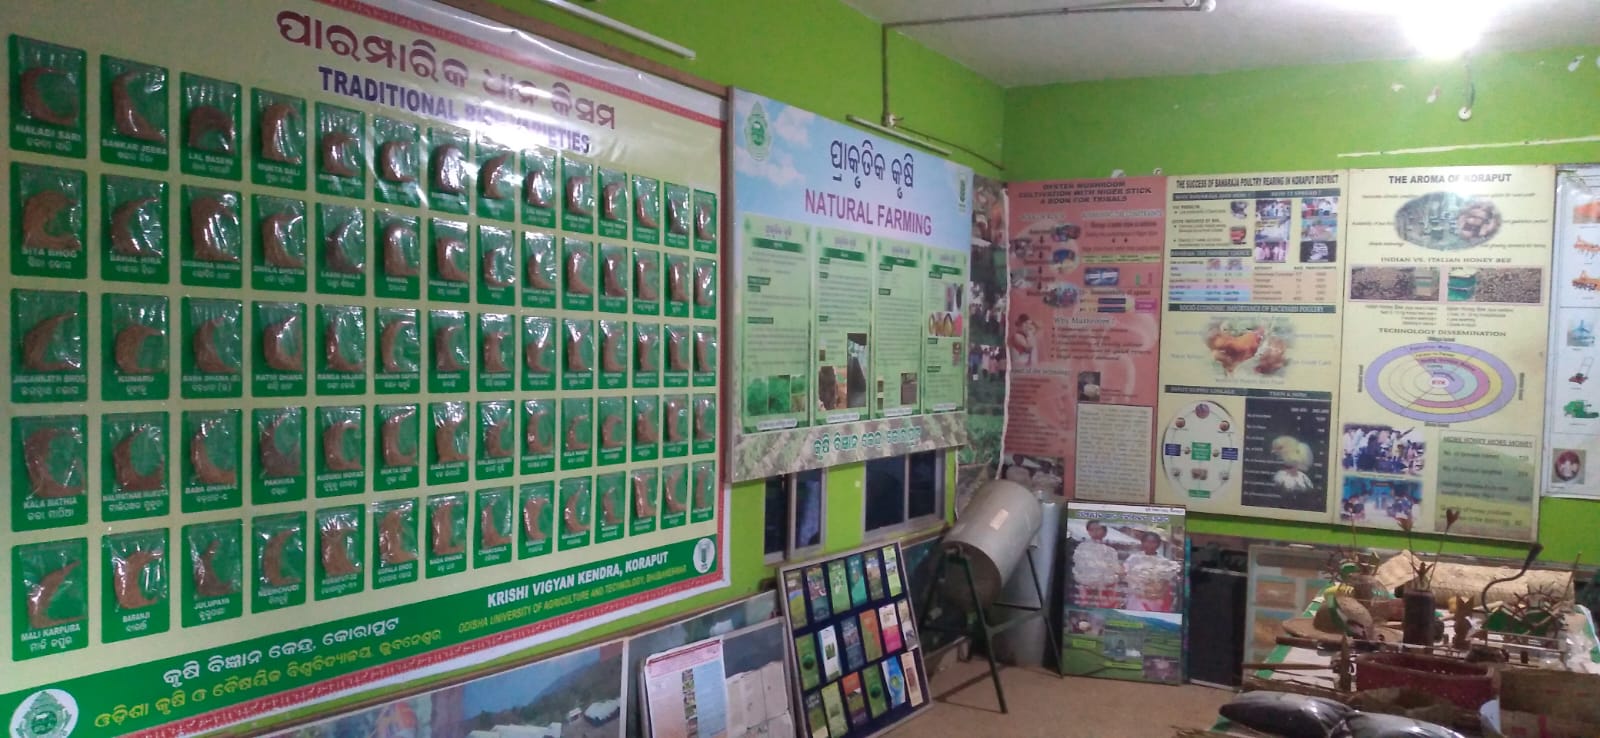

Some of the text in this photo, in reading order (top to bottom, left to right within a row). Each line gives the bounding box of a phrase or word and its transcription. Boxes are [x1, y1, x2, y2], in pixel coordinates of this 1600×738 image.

[276, 10, 615, 130] ପାରମ୍ପାରିକ ଧାନ କିସମ
[318, 66, 458, 122] TRADITIONAL
[830, 139, 915, 200] ପ୍ରାକୃତିକ କୃଷି
[1073, 189, 1096, 197] WITH
[1126, 186, 1153, 195] STICK
[1076, 181, 1126, 189] MUSHROOM
[1176, 180, 1185, 189] THE
[1186, 179, 1207, 189] SUCCESS
[1208, 179, 1214, 188] OF
[1240, 178, 1262, 187] POULTRY
[1263, 177, 1285, 186] REARING
[1285, 177, 1291, 185] IN
[1291, 175, 1315, 185] KORAPUT
[1315, 174, 1339, 184] DISTRICT
[1388, 173, 1512, 184] THE AROMA OF KORAPUT
[804, 188, 932, 237] NATURAL FARMING
[1378, 327, 1507, 338] TECHNOLOGY DISSEMINATION
[487, 551, 669, 608] KRISHI VIGYAN KENDRA, KORAPUT
[458, 618, 488, 634] ODISHA
[489, 605, 532, 625] UNIVERSITY
[533, 603, 542, 614] OF
[543, 589, 590, 610] AGRICULTURE
[591, 587, 604, 598] AND
[163, 661, 201, 689] କୃଷି
[207, 649, 262, 675] ବିଜ୍ଞାନ
[322, 617, 400, 646] କୋରାପୁଟ
[154, 688, 186, 715] କୃଷି
[191, 688, 205, 702] ଓ
